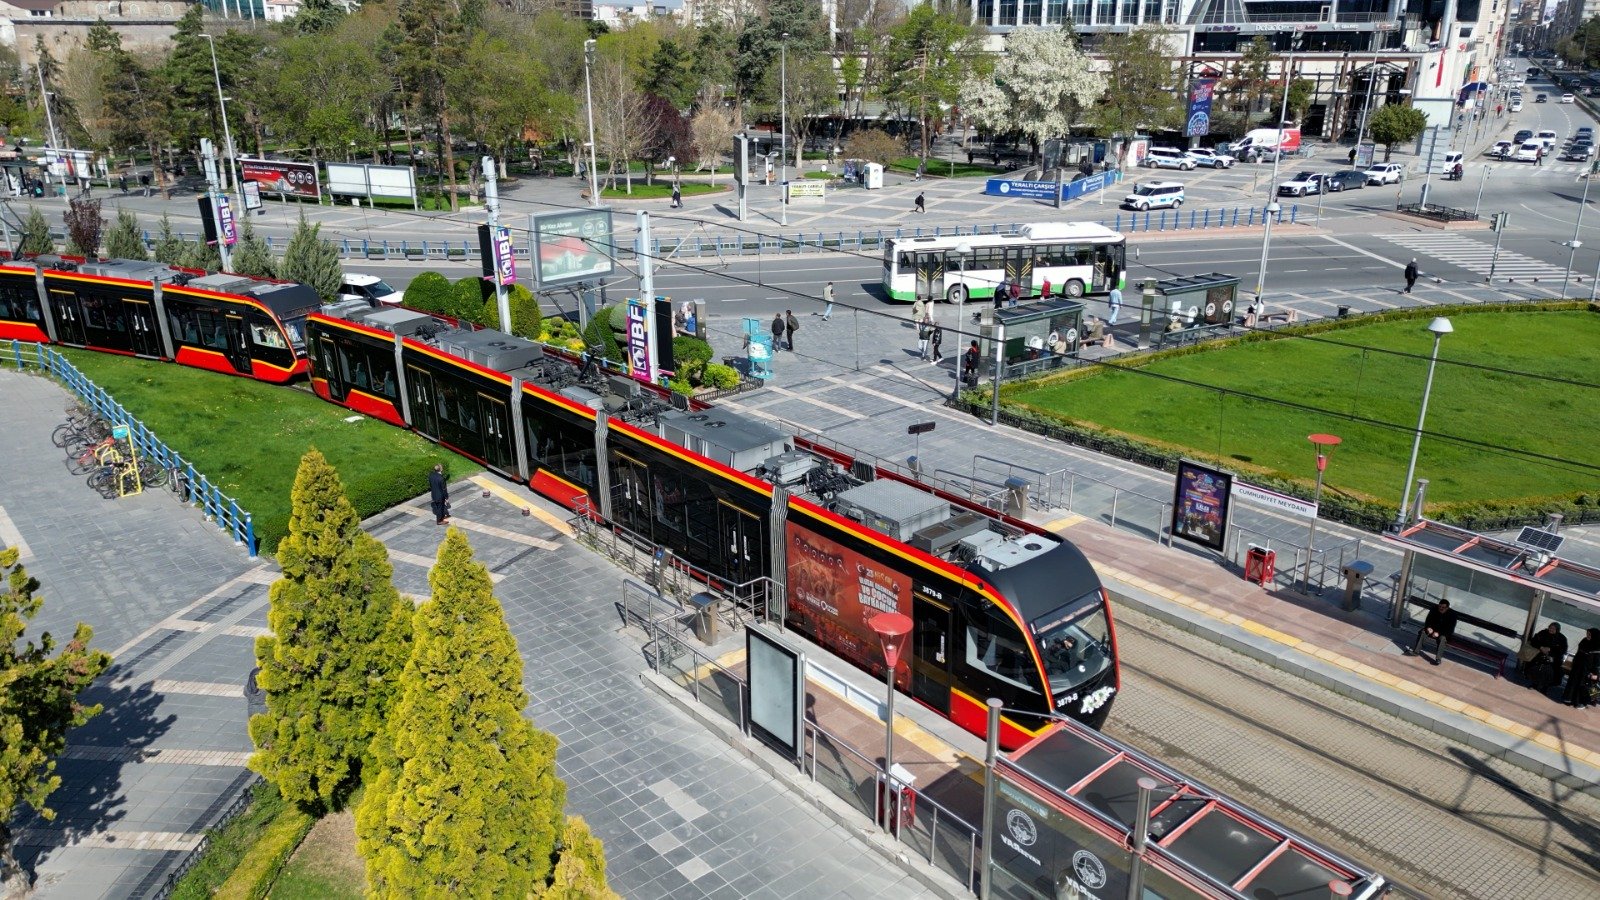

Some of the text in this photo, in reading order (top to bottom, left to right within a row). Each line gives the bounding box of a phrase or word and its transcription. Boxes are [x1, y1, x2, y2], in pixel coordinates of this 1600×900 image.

[1238, 488, 1307, 513] CUMHURİYET MEYDANI
[922, 585, 942, 600] 3879-B
[1057, 693, 1078, 708] 3879-B
